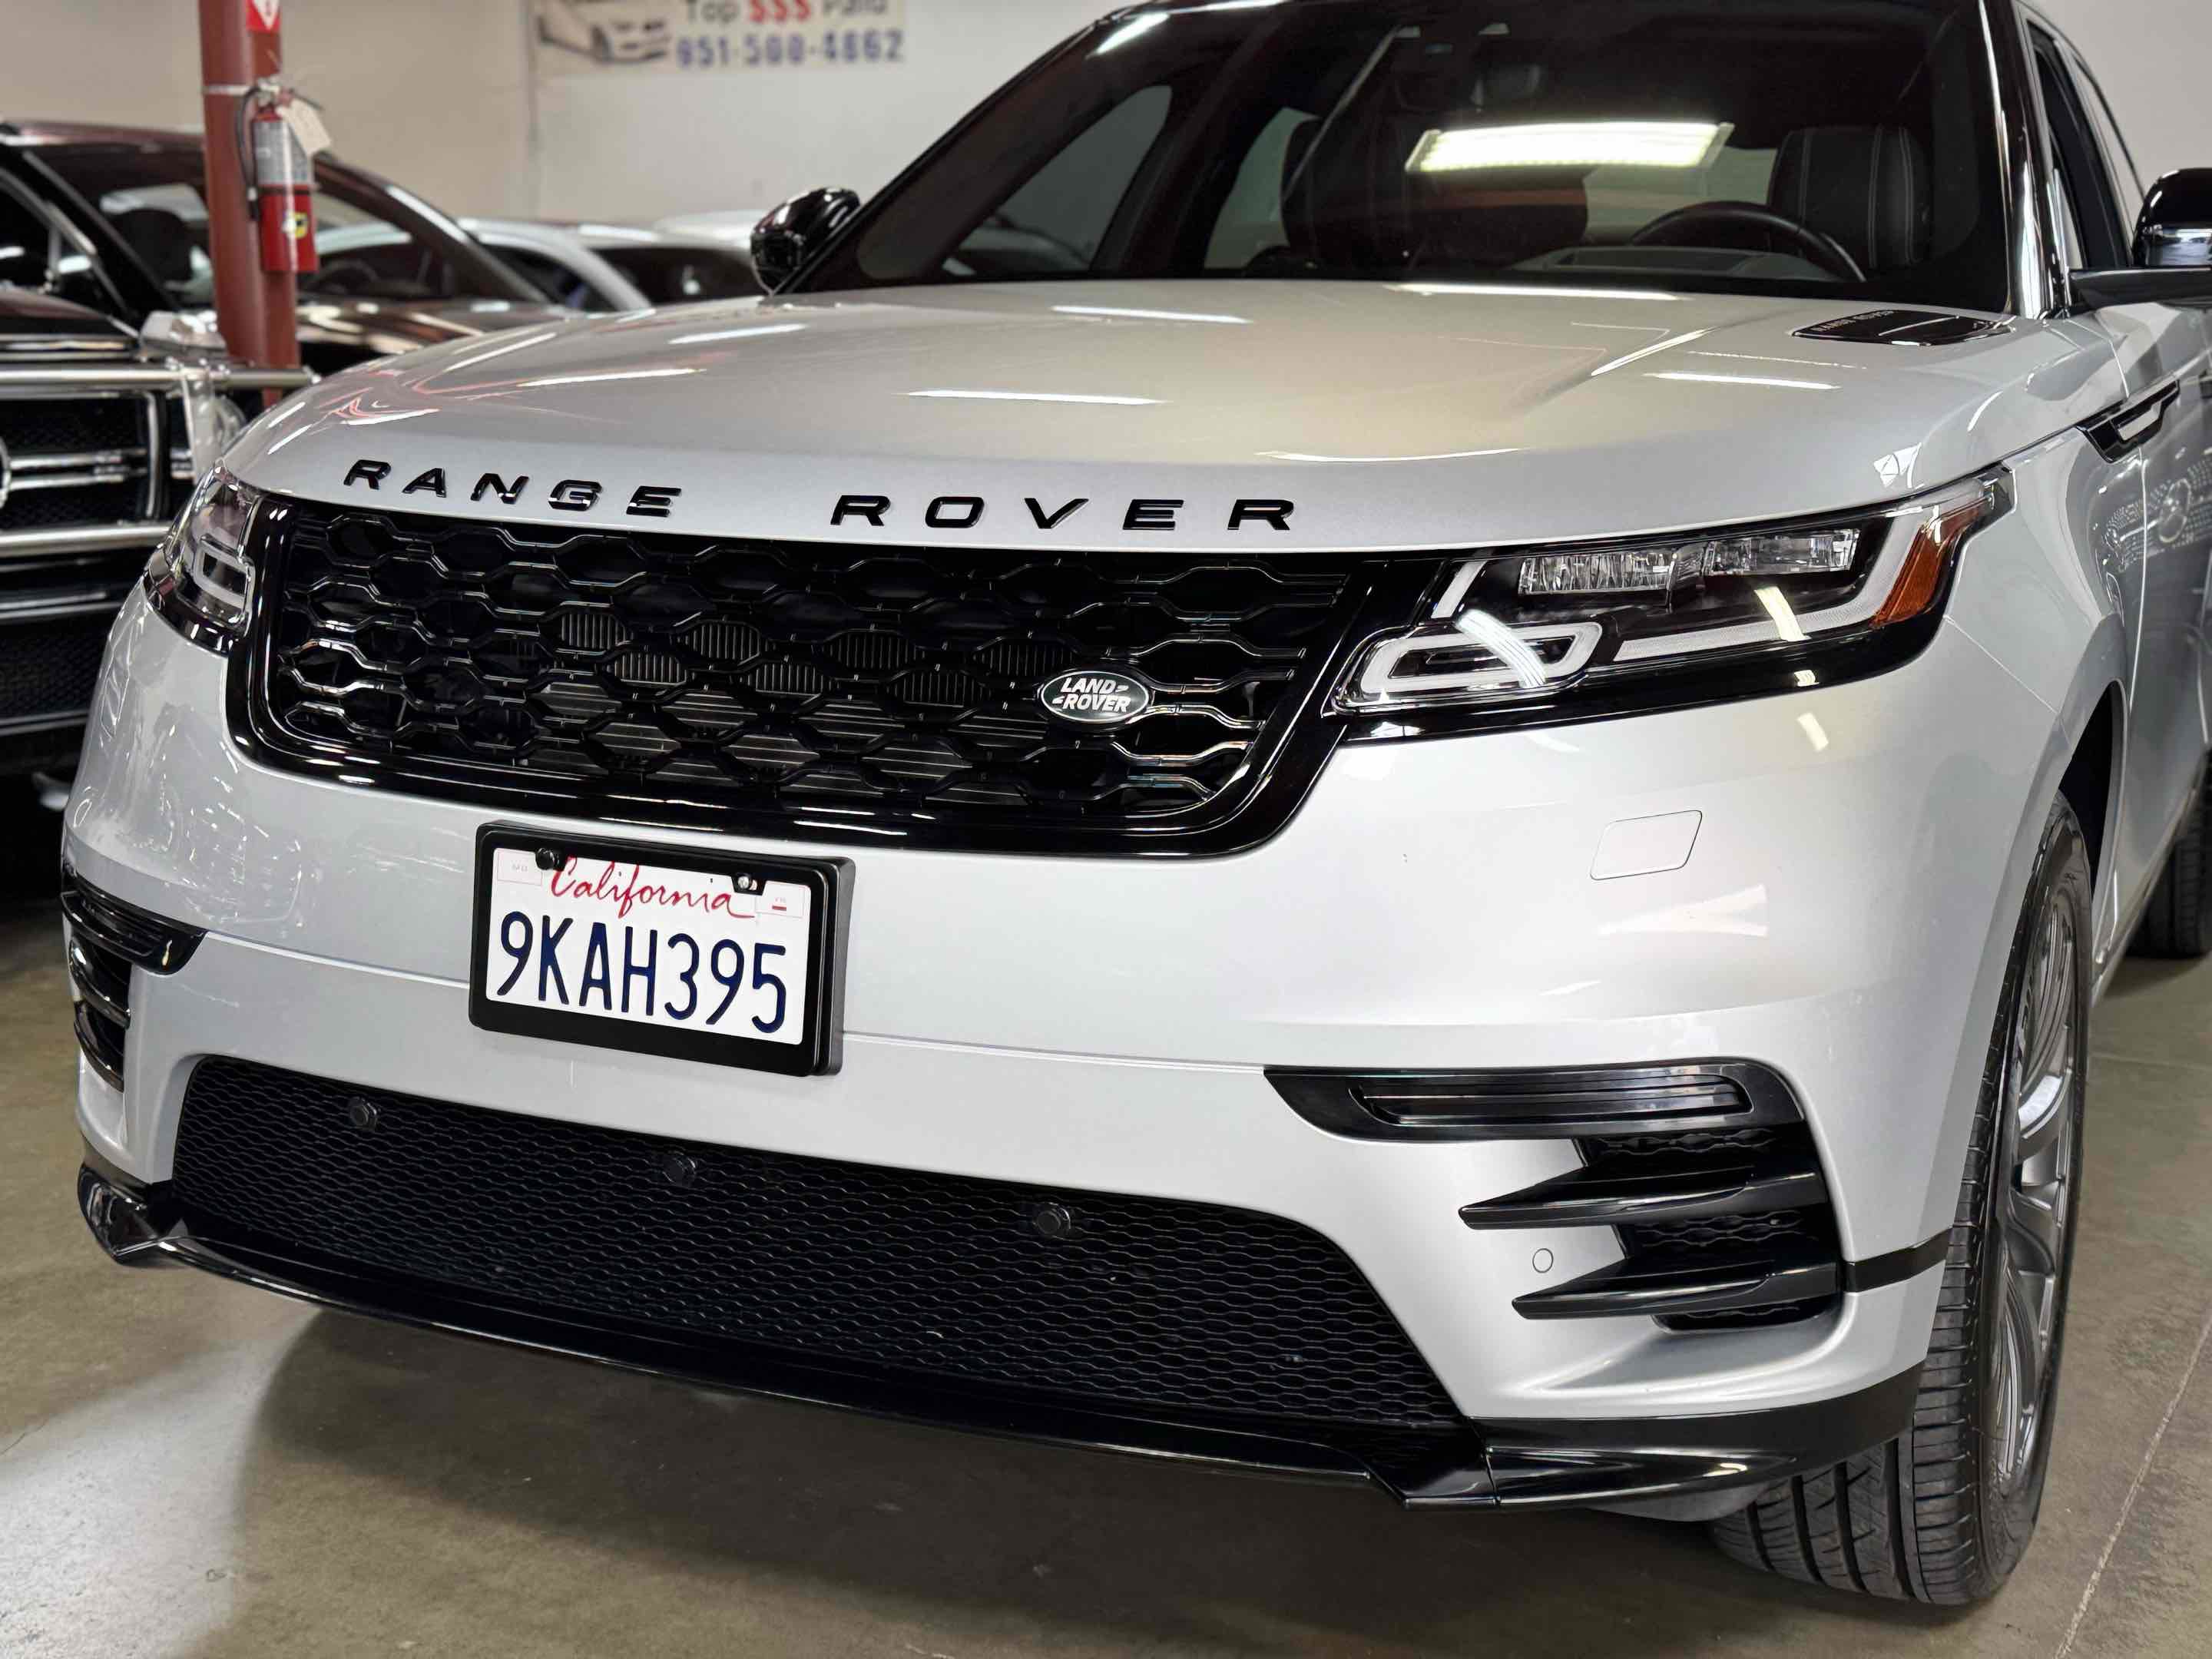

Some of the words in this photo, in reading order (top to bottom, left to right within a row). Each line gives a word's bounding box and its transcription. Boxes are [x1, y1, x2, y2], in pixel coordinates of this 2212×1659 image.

[343, 459, 682, 517] RANGE
[830, 495, 1294, 531] ROVER
[1061, 677, 1117, 694] LAND
[1062, 694, 1131, 712] ROVER
[551, 855, 756, 919] California
[497, 911, 786, 1034] 9KAH395
